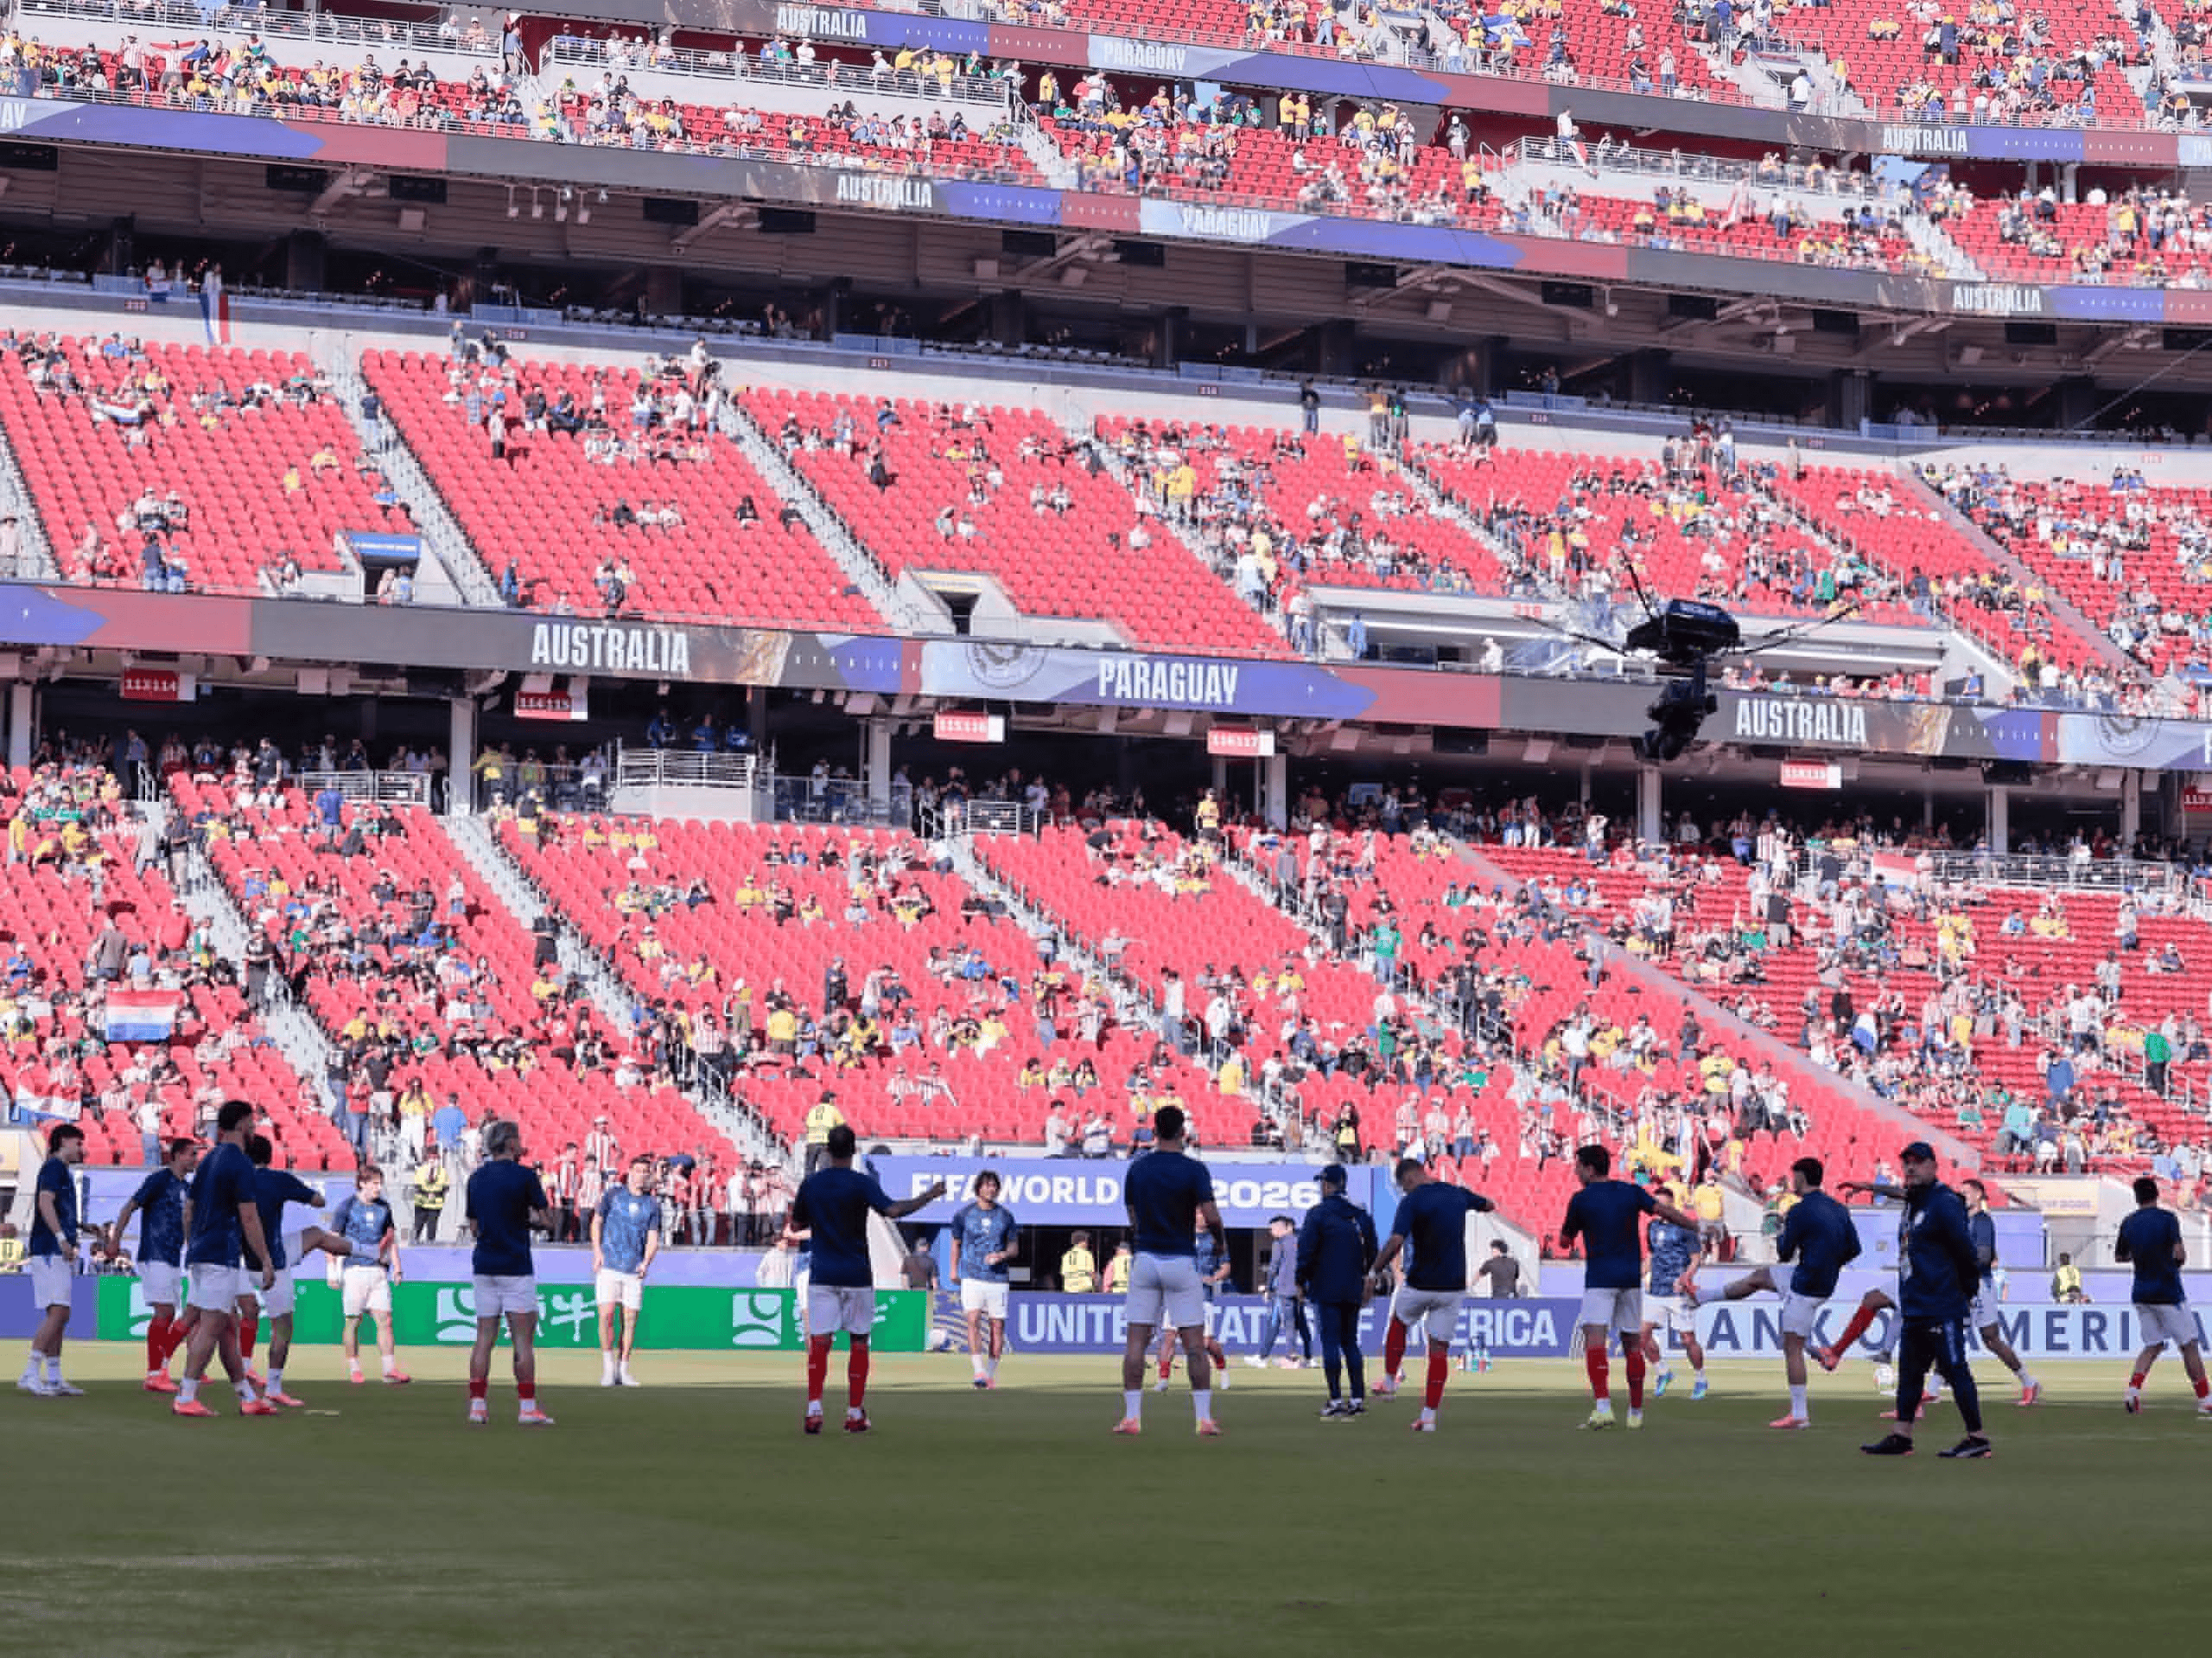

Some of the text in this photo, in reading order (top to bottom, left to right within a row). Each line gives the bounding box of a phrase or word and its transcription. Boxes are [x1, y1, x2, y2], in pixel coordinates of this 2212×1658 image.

[775, 7, 867, 39] AUSTRALIA
[1103, 40, 1187, 71] PARAGUAY
[1882, 127, 1968, 153] AUSTRALIA
[836, 175, 933, 208] AUSTRALIA
[1953, 283, 2043, 313] AUSTRALIA
[531, 622, 690, 671] AUSTRALIA
[1098, 657, 1238, 706] PARAGUAY
[1735, 697, 1868, 744] AUSTRALIA
[996, 1174, 1122, 1204] WORLD
